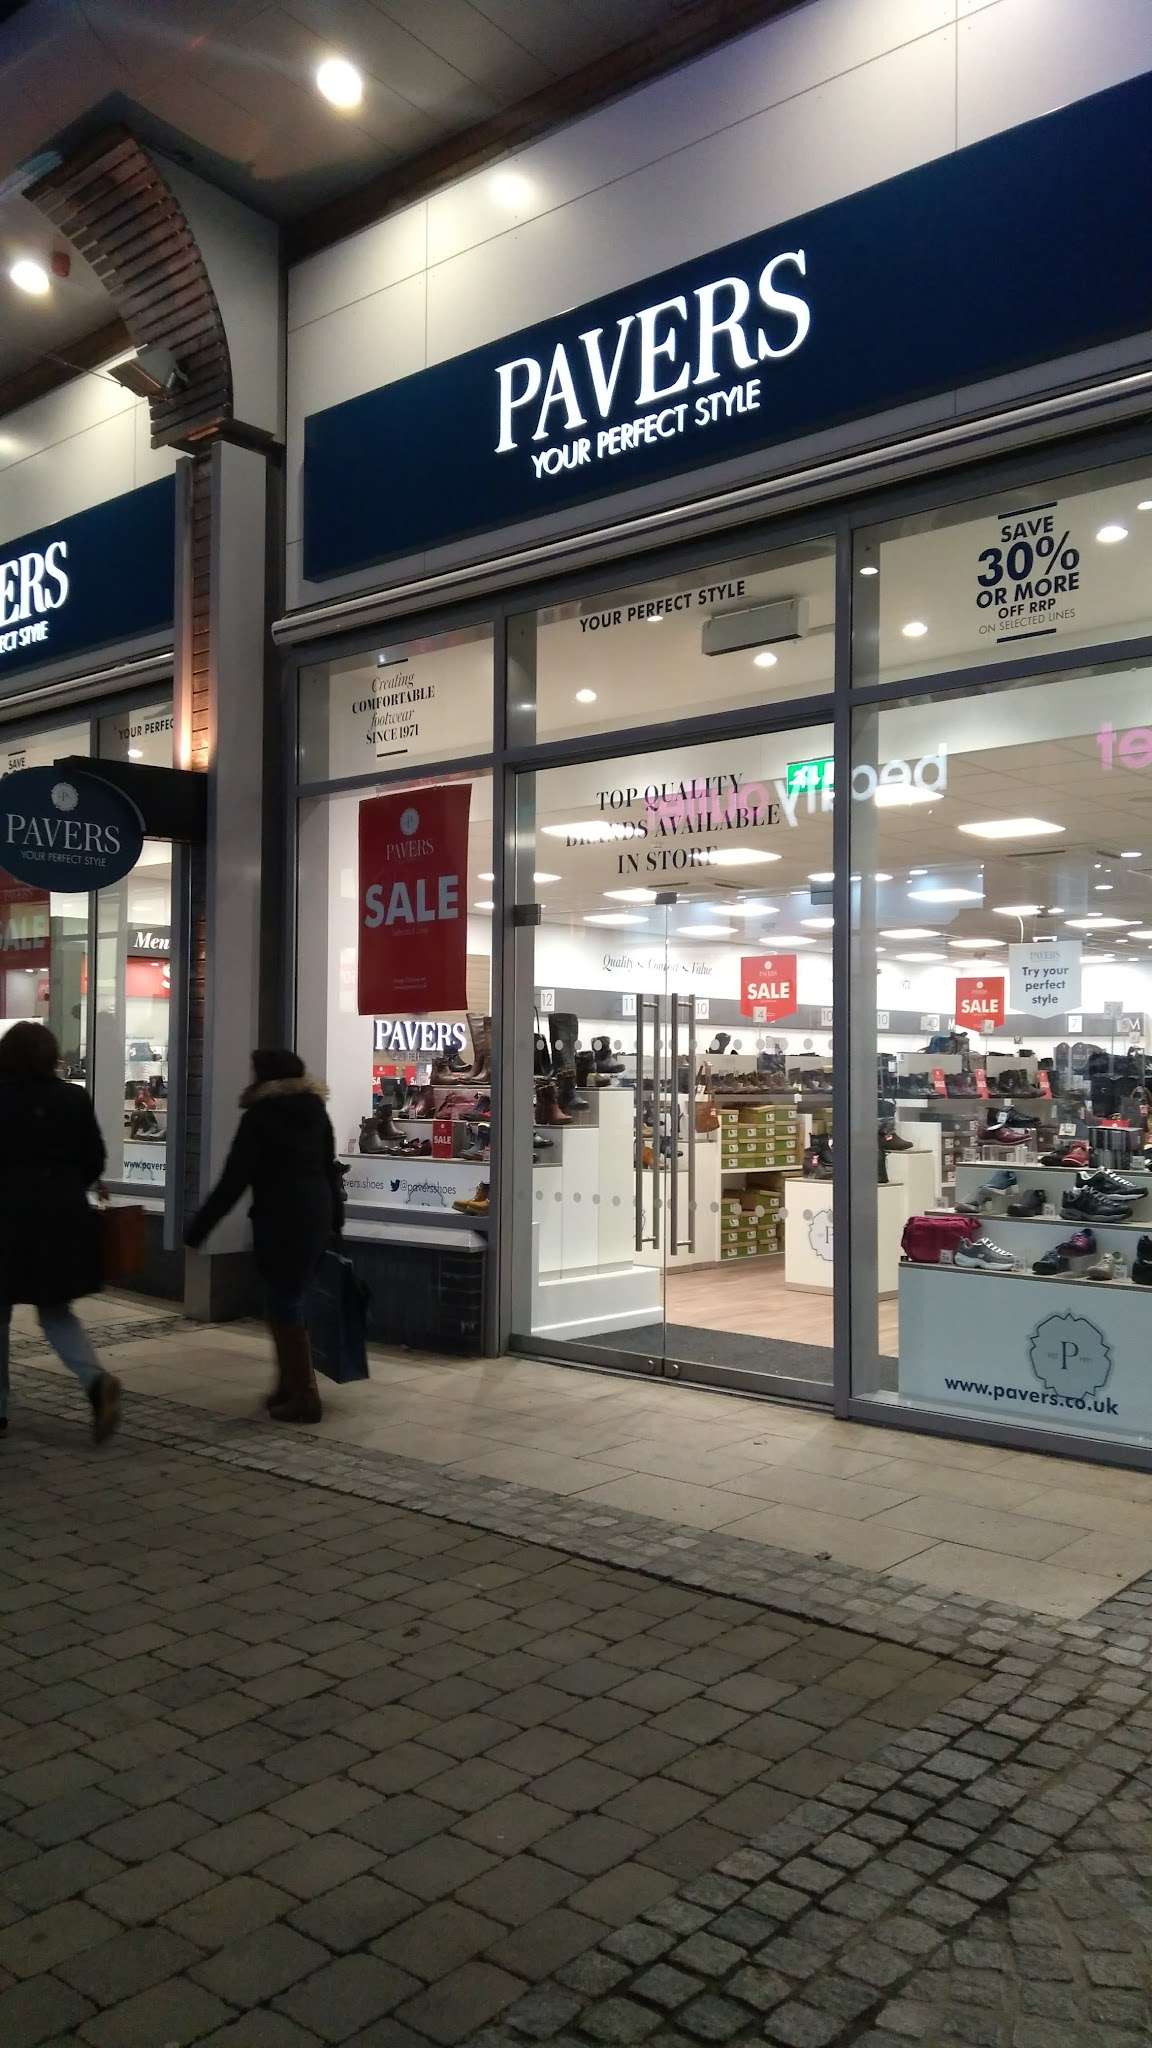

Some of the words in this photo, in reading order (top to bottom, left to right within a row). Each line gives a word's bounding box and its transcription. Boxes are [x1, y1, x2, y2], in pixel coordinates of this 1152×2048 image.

[494, 249, 811, 453] PAVERS
[531, 438, 591, 479] YOUR
[597, 403, 689, 459] PERFECT
[694, 378, 761, 427] STYLE
[1001, 516, 1054, 543] SAVE
[977, 530, 1080, 588] 30%
[976, 587, 1008, 609] OR
[1014, 571, 1080, 602] MORE
[580, 610, 622, 633] YOUR
[627, 593, 693, 622] PERFECT
[698, 580, 746, 606] STYLE
[998, 604, 1025, 619] OFF
[1029, 598, 1056, 614] RRP
[978, 624, 996, 635] ON
[999, 614, 1046, 631] SELECTED
[1048, 608, 1076, 622] LINES
[371, 672, 415, 693] Creating
[351, 684, 436, 714] COMFORTABLE
[118, 725, 142, 741] YOUR
[366, 728, 398, 745] SINCE
[399, 723, 419, 740] 1971
[8, 757, 26, 770] SAVE
[597, 788, 638, 811] TOP
[644, 773, 743, 812] QUALITY
[654, 803, 781, 838] AVAILABLE
[5, 813, 121, 855] PAVERS
[20, 850, 46, 861] YOUR
[48, 852, 82, 865] PERFECT
[85, 857, 107, 868] STYLE
[386, 838, 435, 862] PAVERS
[618, 854, 640, 874] IN
[364, 874, 459, 929] SALE
[133, 931, 170, 950] Men
[1022, 966, 1040, 978] Try
[1043, 966, 1070, 978] your
[747, 982, 790, 1000] SALE
[1025, 979, 1067, 993] perfect
[961, 999, 999, 1014] SALE
[1032, 994, 1058, 1007] style
[374, 1020, 467, 1052] PAVERS
[433, 1135, 452, 1145] SALE
[1061, 1341, 1079, 1370] P
[944, 1377, 1120, 1416] www.pavers.co.uk
